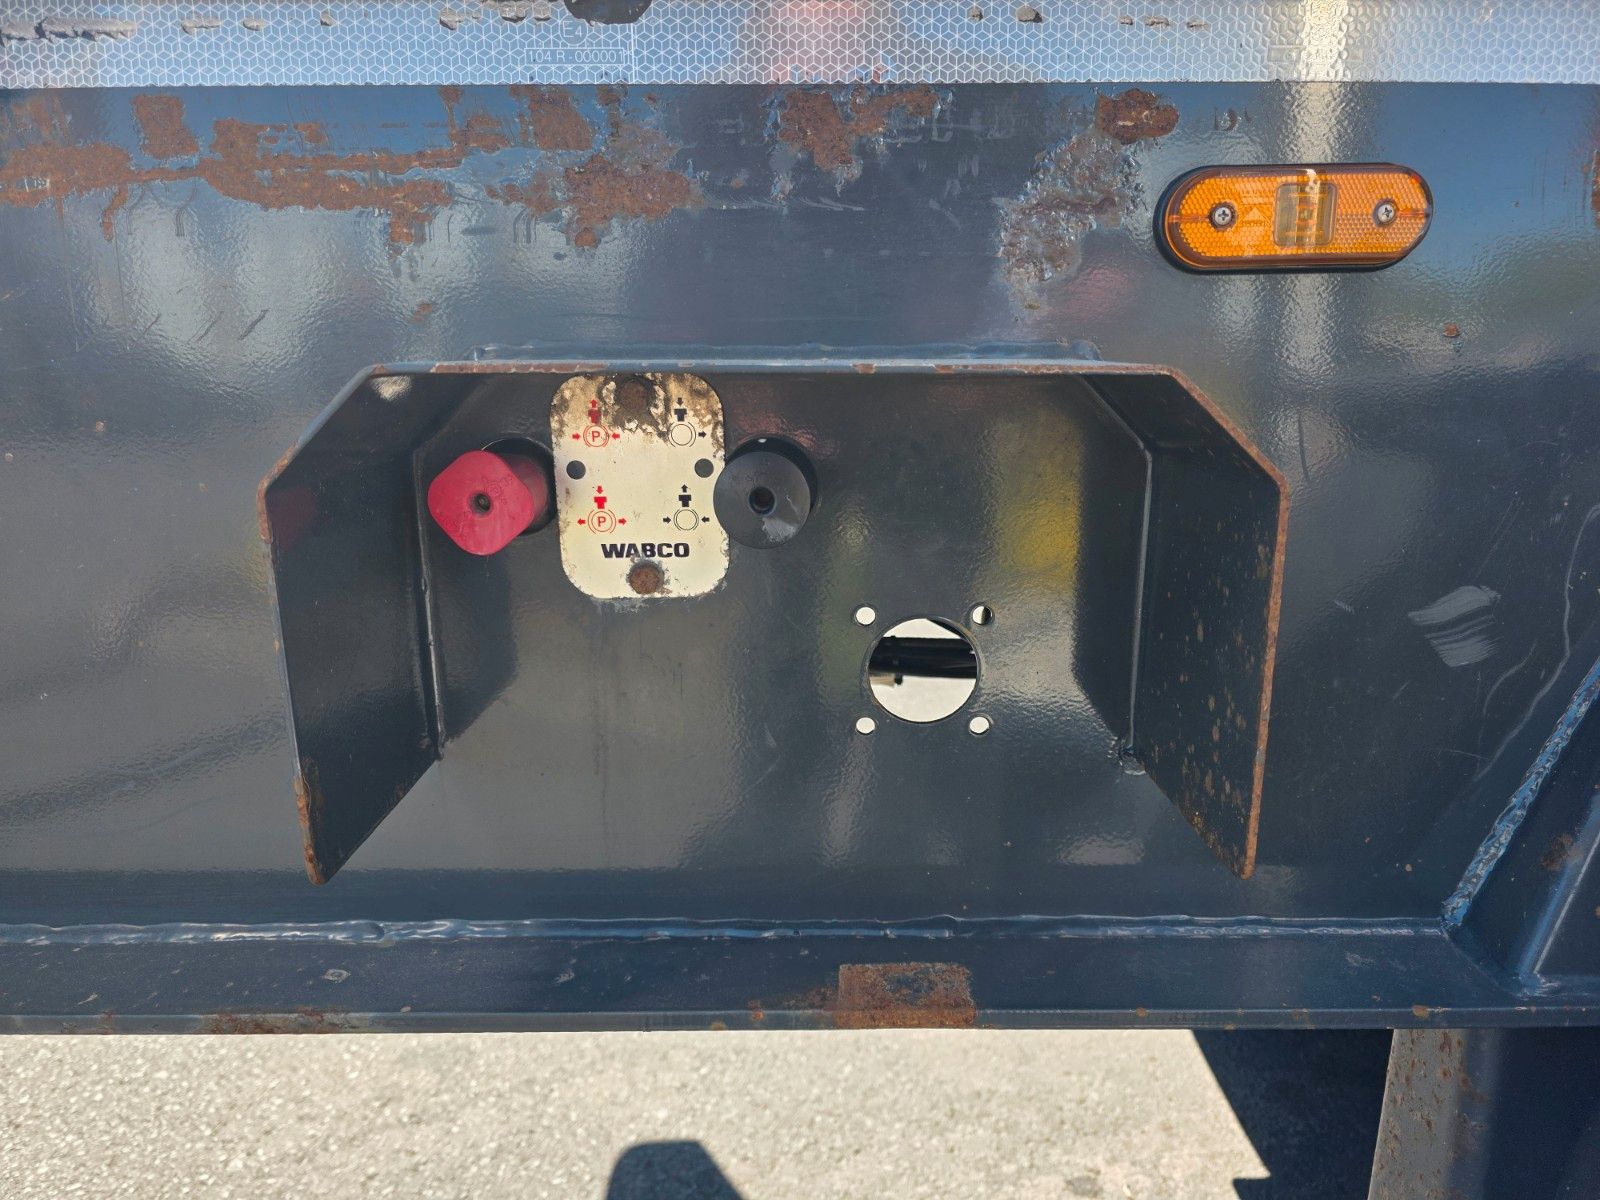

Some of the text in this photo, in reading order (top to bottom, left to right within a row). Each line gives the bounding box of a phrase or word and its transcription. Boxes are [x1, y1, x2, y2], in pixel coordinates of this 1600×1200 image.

[591, 430, 601, 442] P
[597, 516, 606, 527] P
[601, 542, 691, 559] WABCO
